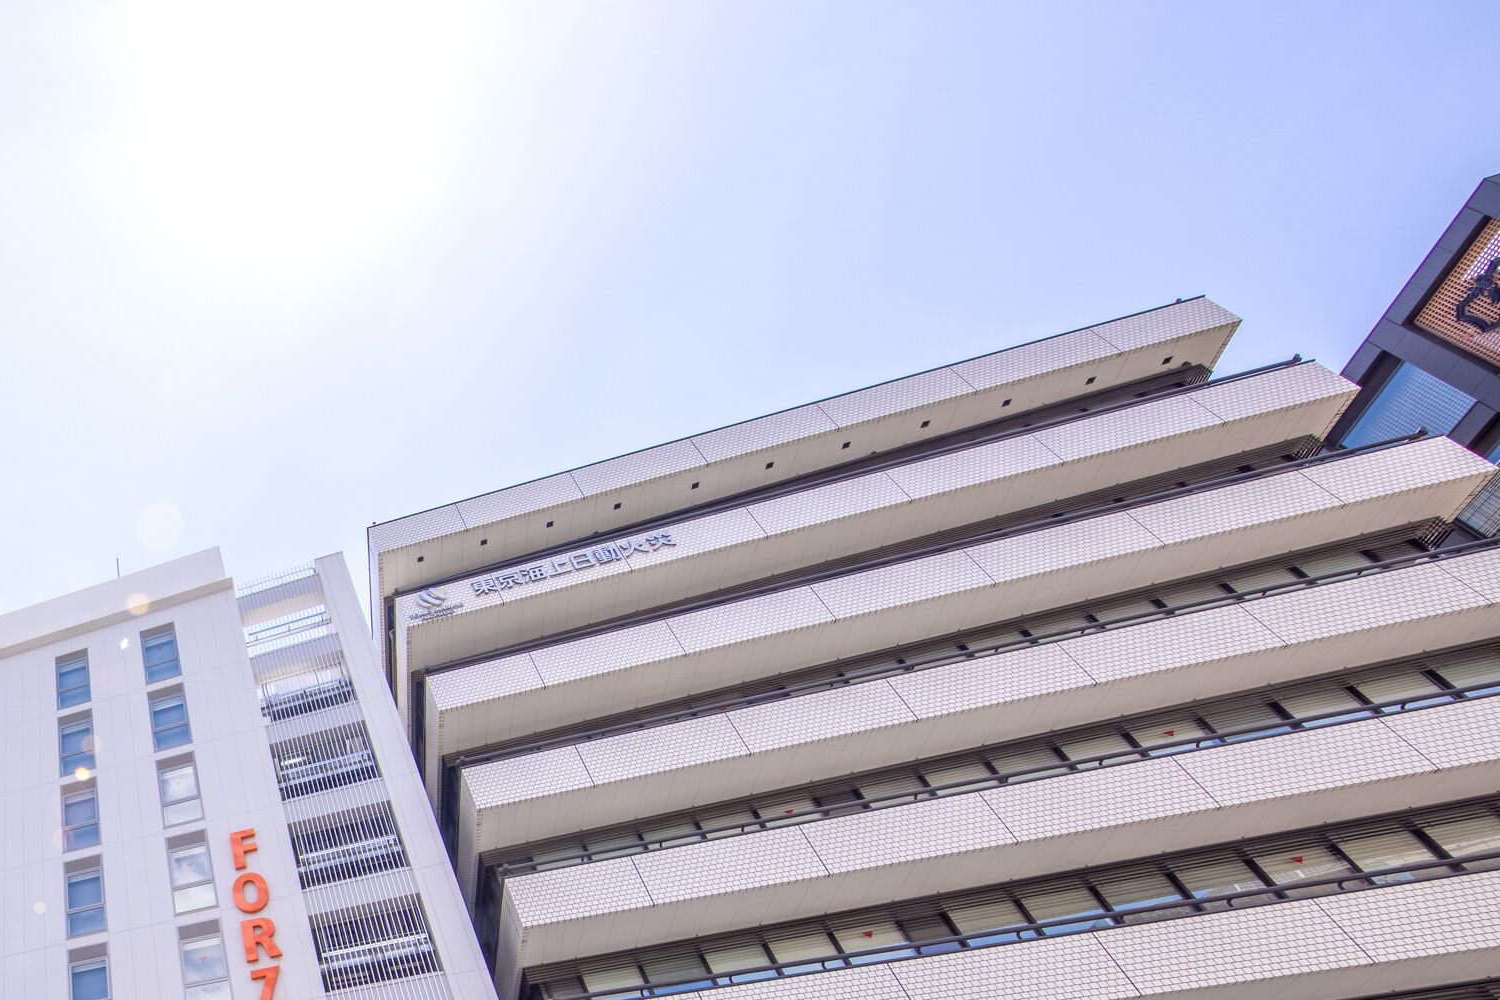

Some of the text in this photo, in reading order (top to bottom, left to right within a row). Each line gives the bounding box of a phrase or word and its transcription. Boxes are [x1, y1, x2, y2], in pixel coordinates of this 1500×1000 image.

[471, 532, 677, 596] 東京海上日動火災
